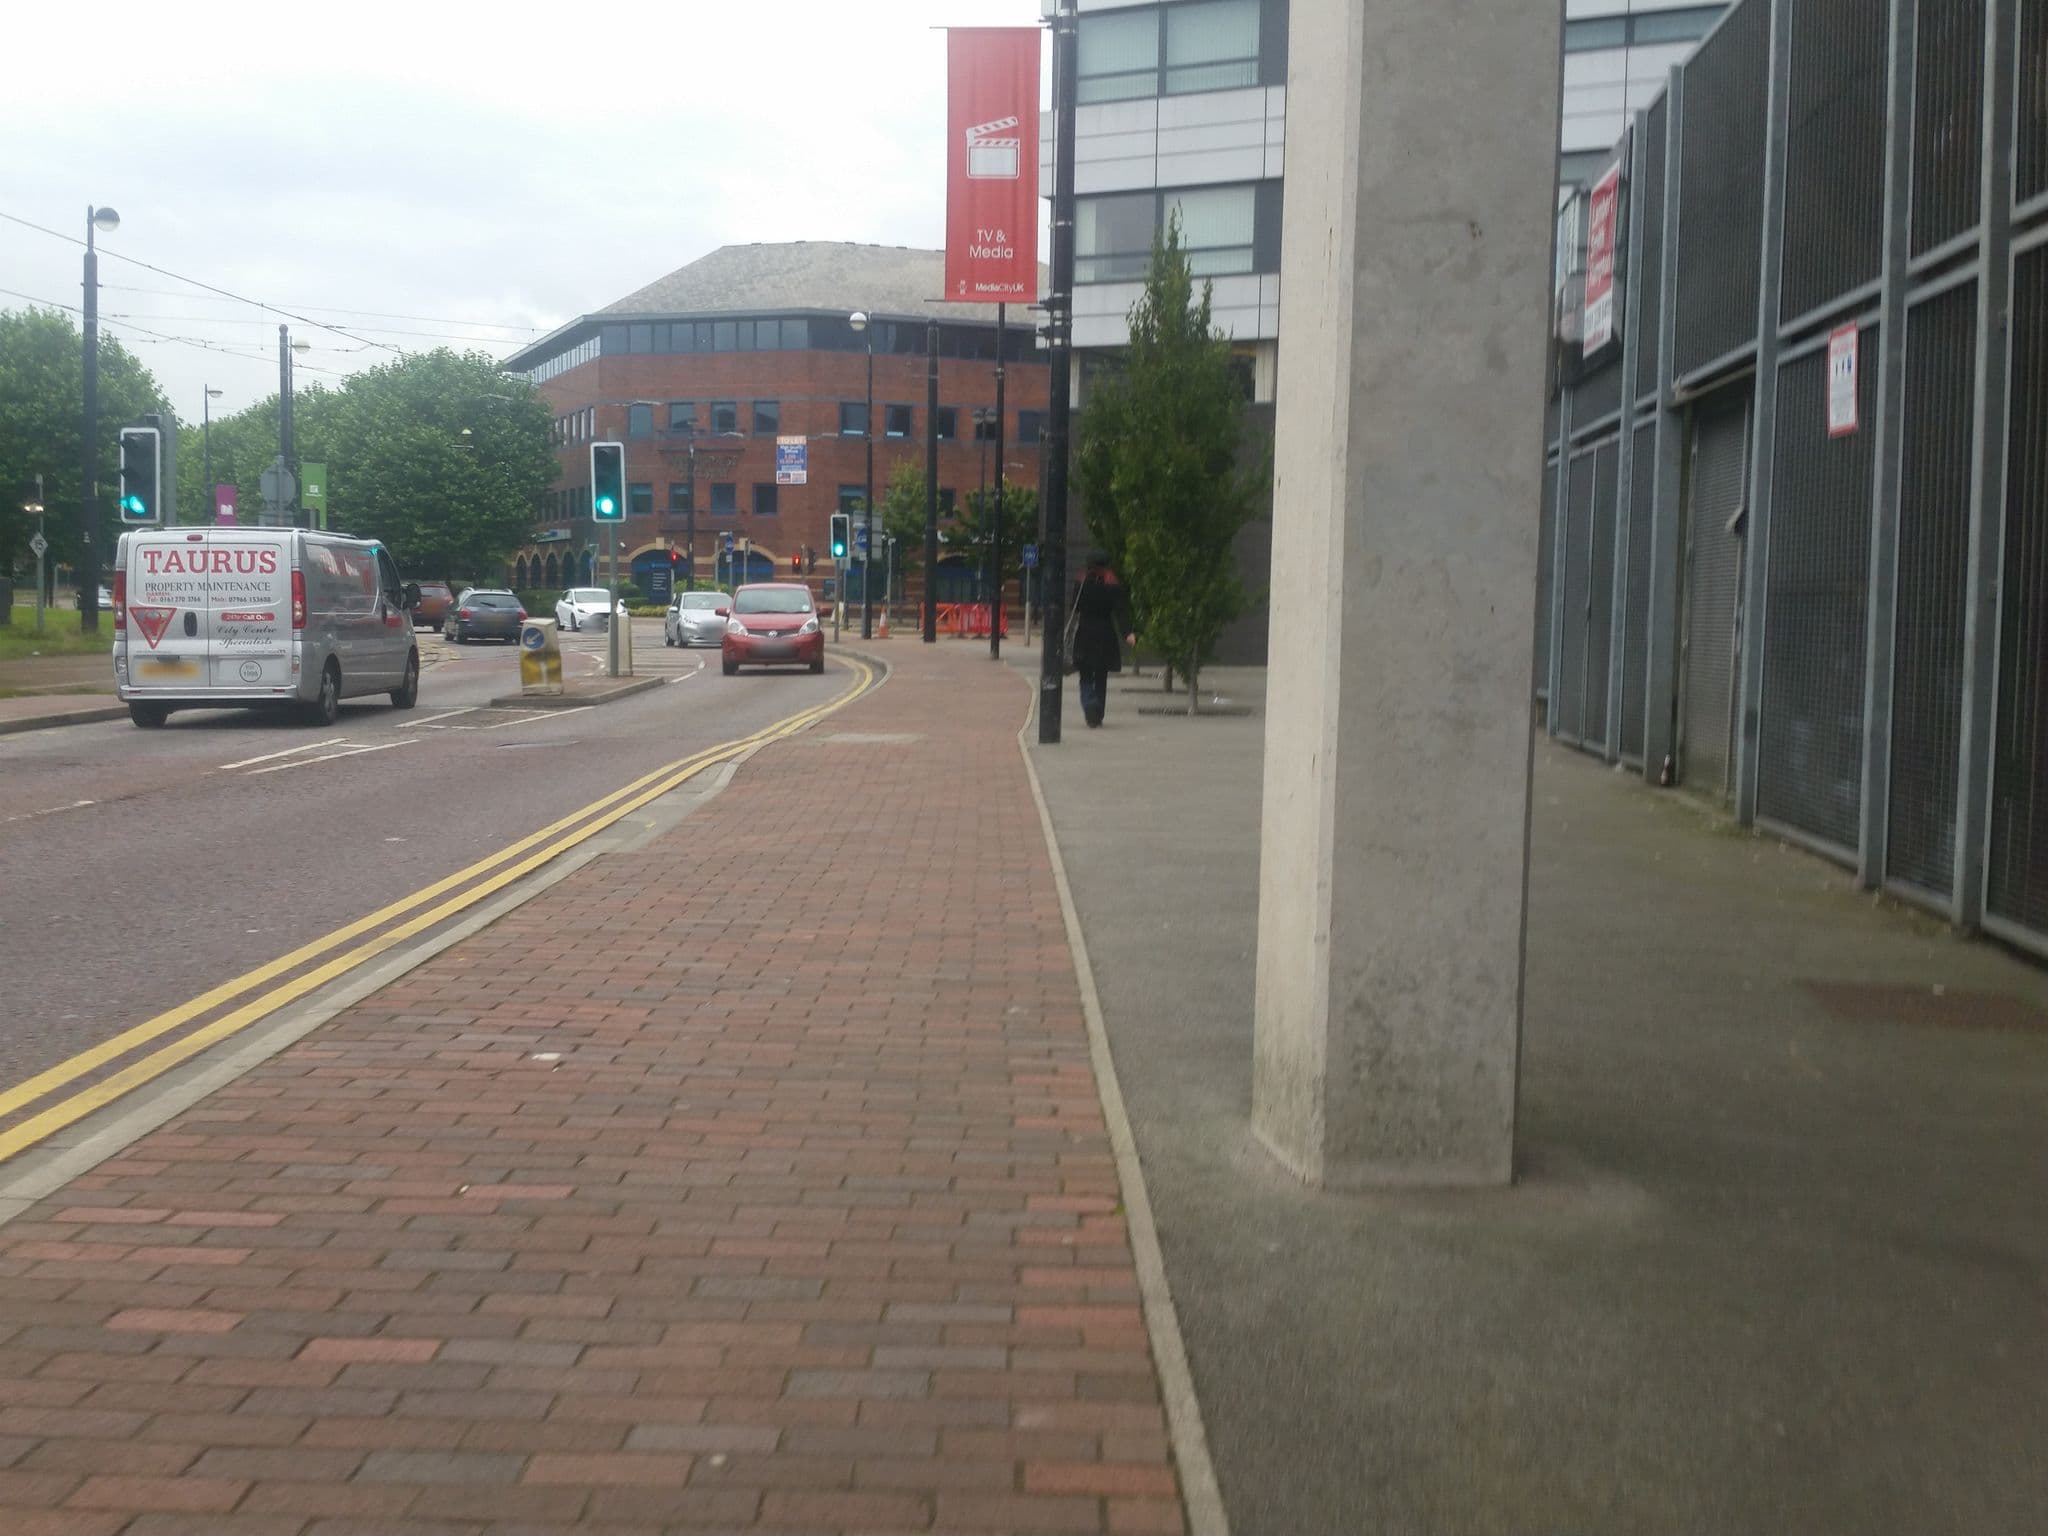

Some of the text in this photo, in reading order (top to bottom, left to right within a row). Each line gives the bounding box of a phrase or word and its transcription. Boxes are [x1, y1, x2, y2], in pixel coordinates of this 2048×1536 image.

[977, 229, 1006, 243] TV &
[969, 245, 1014, 259] Media
[143, 550, 277, 575] TAURUS
[145, 581, 271, 592] PROPERTY MAINTENANCE
